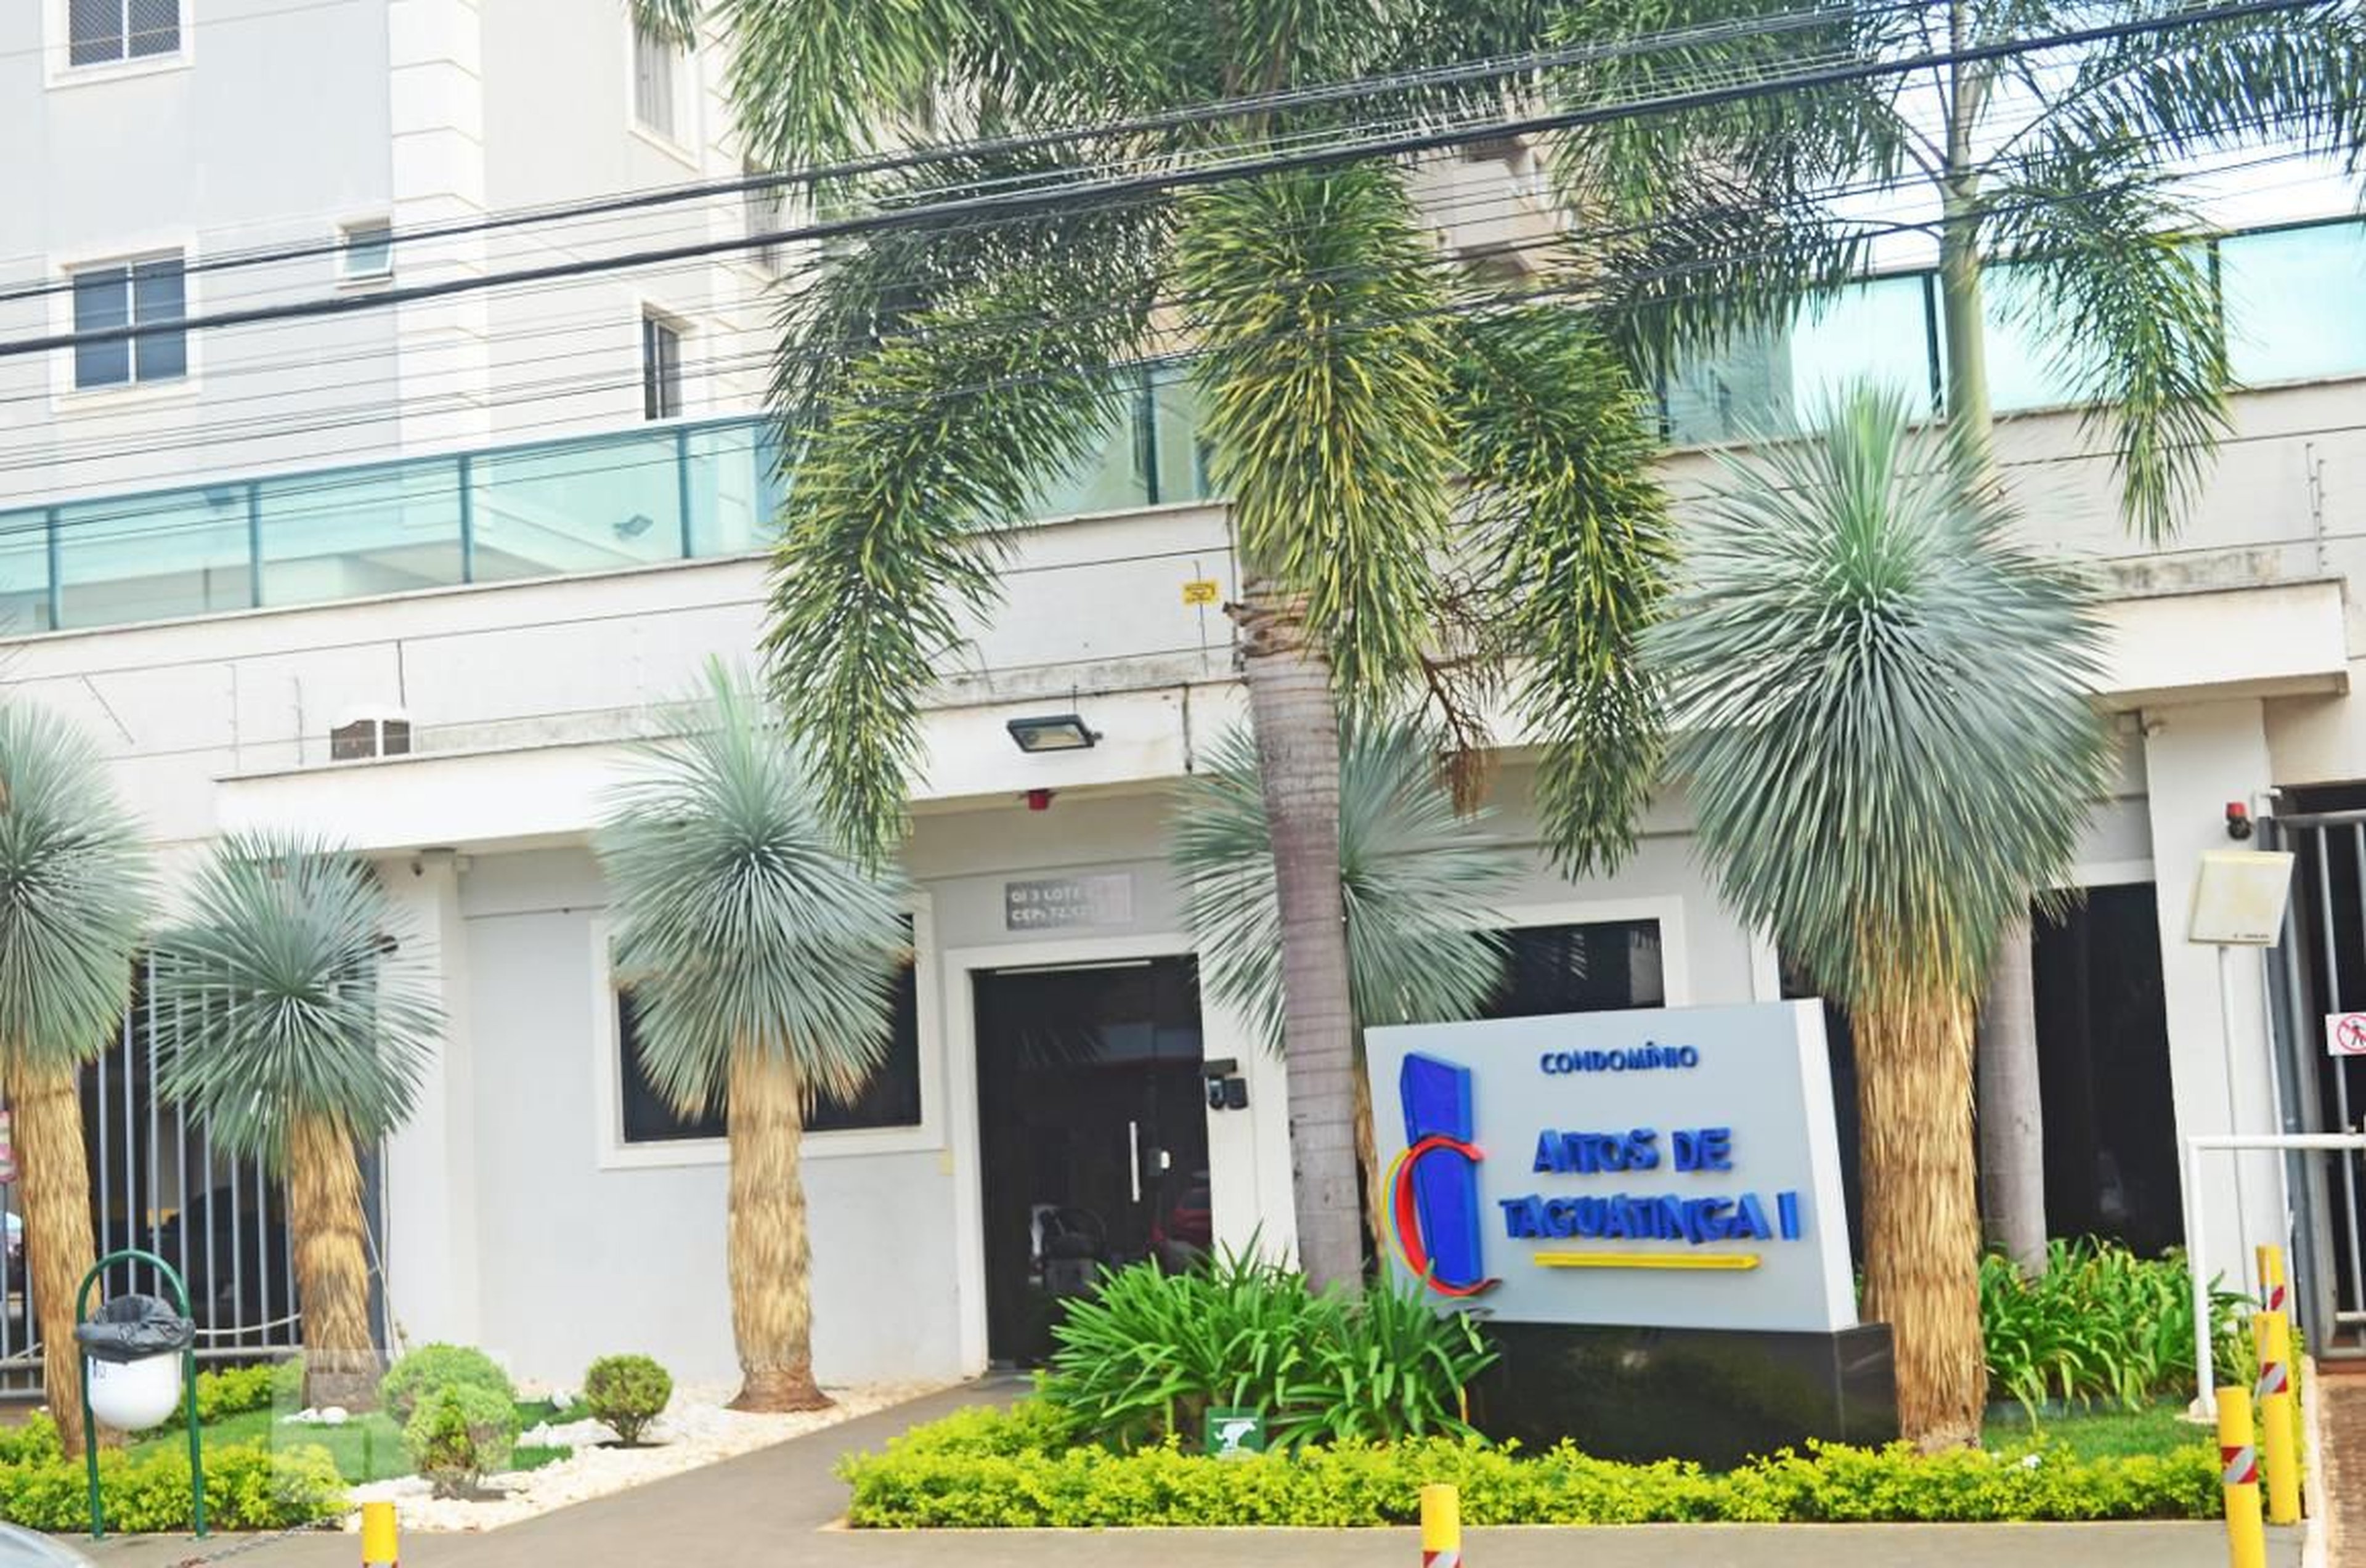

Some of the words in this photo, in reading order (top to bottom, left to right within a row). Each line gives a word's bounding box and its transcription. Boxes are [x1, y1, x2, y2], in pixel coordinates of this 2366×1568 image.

[1540, 1041, 1699, 1074] CONDOMÍNIO
[1533, 1128, 1659, 1173] ALTOS
[1672, 1128, 1733, 1172] DE
[1498, 1193, 1772, 1245] TAGUATINGA
[1777, 1190, 1799, 1240] I
